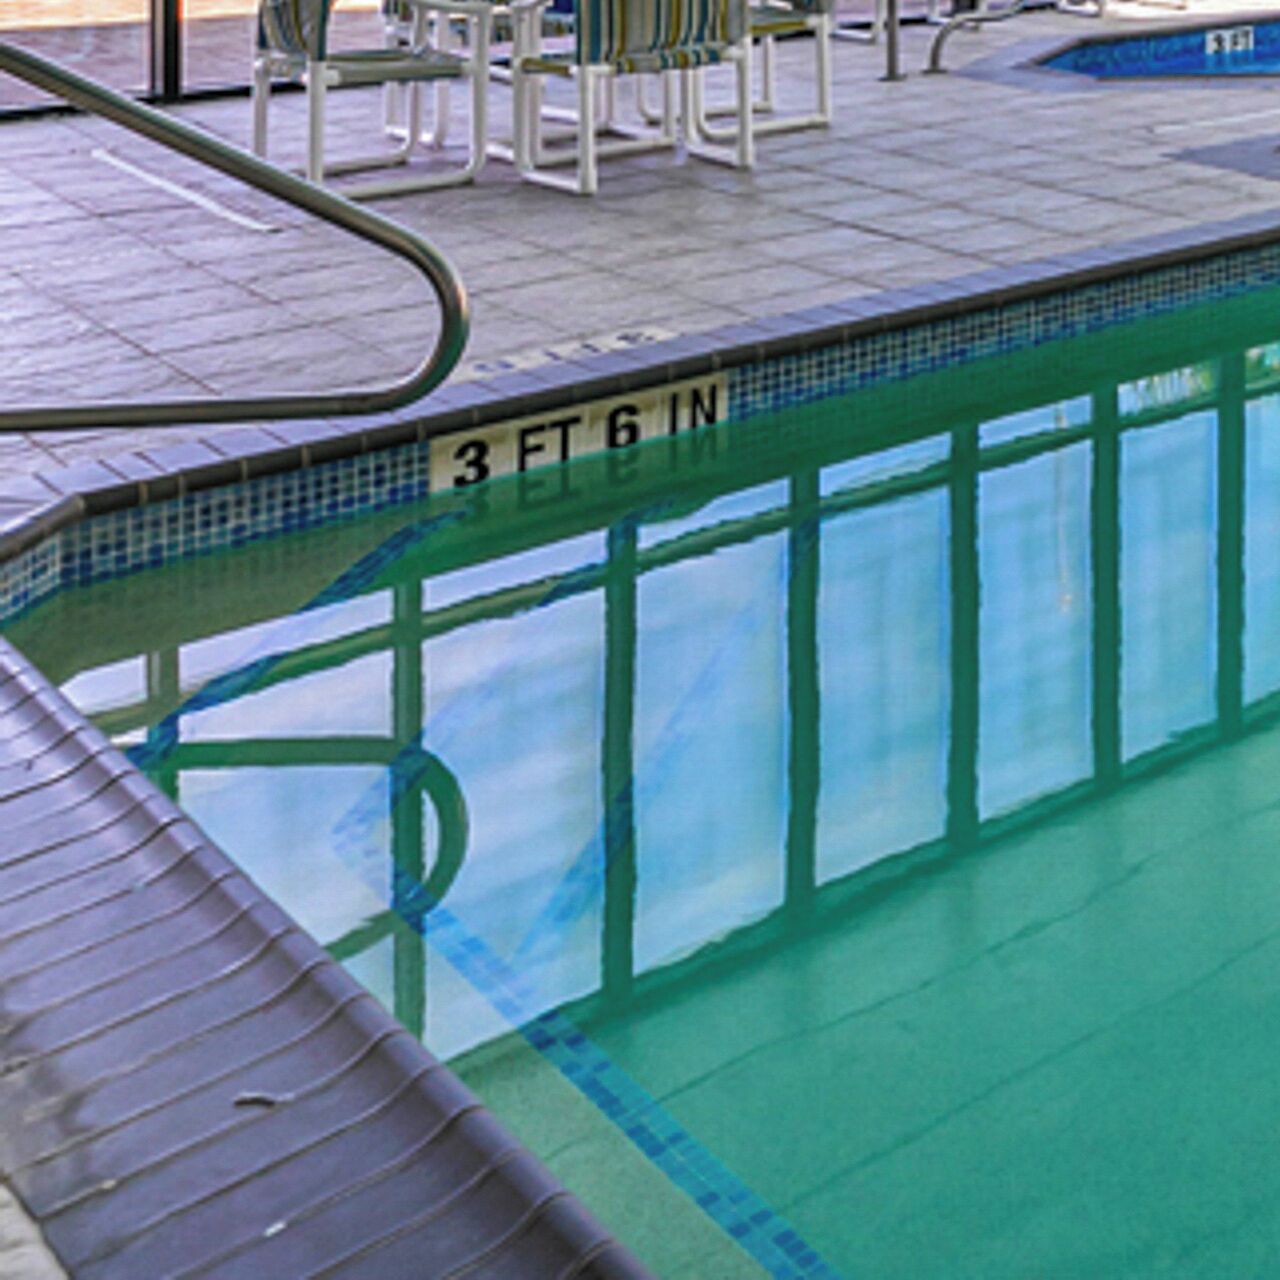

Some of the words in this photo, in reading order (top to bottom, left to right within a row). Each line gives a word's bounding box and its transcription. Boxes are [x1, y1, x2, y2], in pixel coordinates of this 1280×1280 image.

[453, 439, 491, 488] 3
[517, 415, 582, 472] FT
[607, 403, 642, 449] 6
[668, 383, 718, 436] IN
